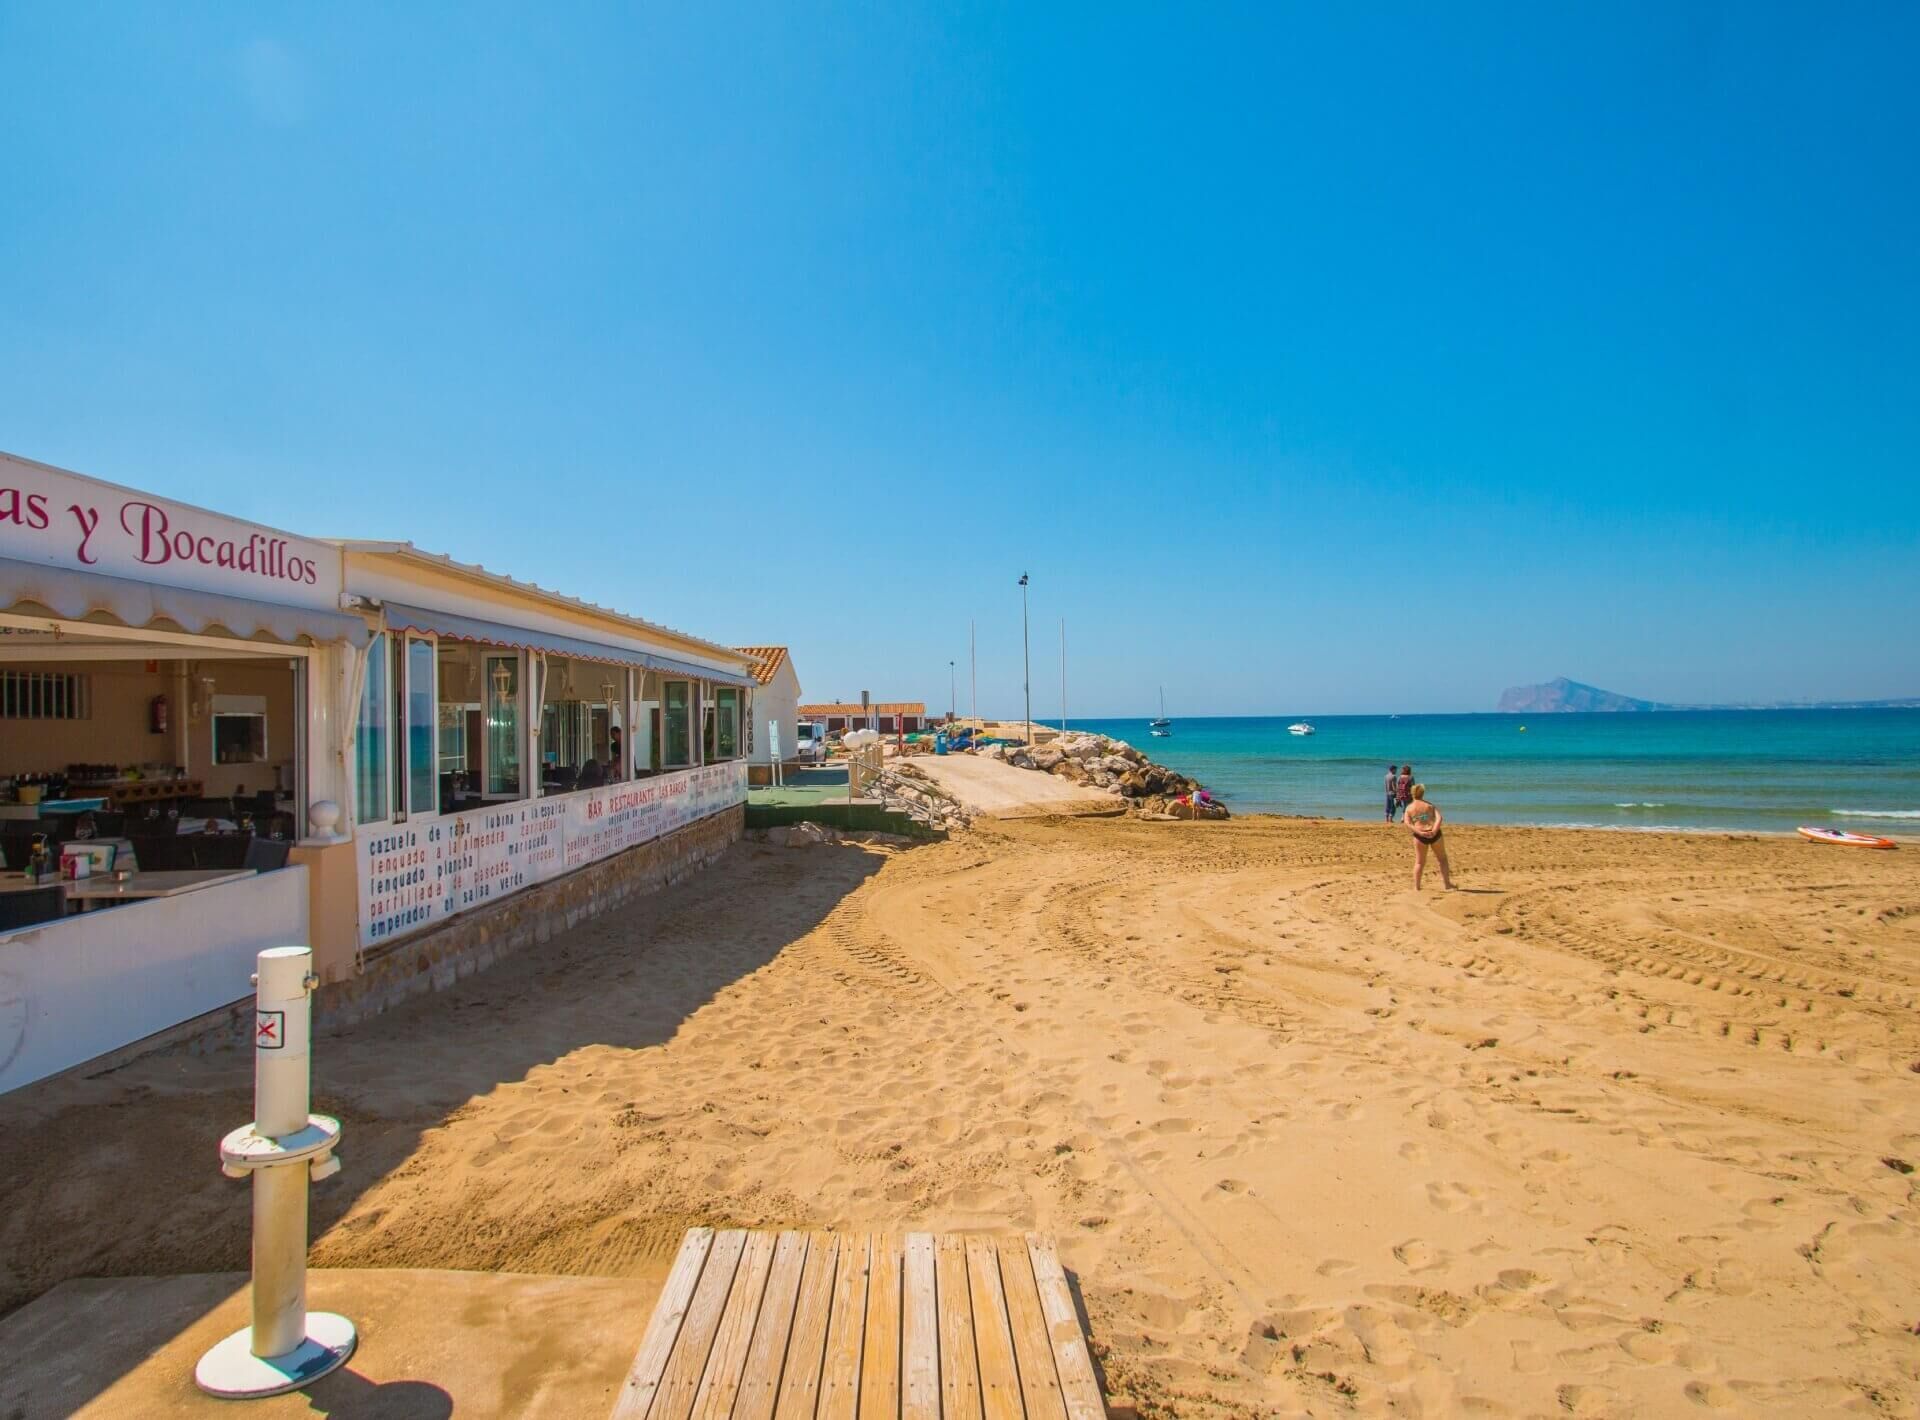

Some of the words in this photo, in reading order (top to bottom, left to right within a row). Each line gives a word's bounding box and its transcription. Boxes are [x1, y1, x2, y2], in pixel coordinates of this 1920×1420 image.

[66, 504, 99, 564] y
[120, 501, 317, 585] Bocadillos
[486, 813, 514, 830] lubina
[541, 801, 566, 819] espalda
[588, 801, 603, 819] BAR
[609, 787, 655, 814] RESTAURANTE
[370, 831, 416, 856] cazuela
[428, 825, 441, 842] de
[436, 846, 441, 859] a
[464, 830, 505, 852] almendra
[508, 832, 548, 856] mariscada
[437, 853, 473, 879] plancha
[370, 881, 442, 921] parrillada
[453, 873, 462, 890] de
[371, 904, 432, 937] emperador
[445, 896, 454, 912] en
[463, 883, 490, 904] salsa
[500, 872, 524, 891] verde
